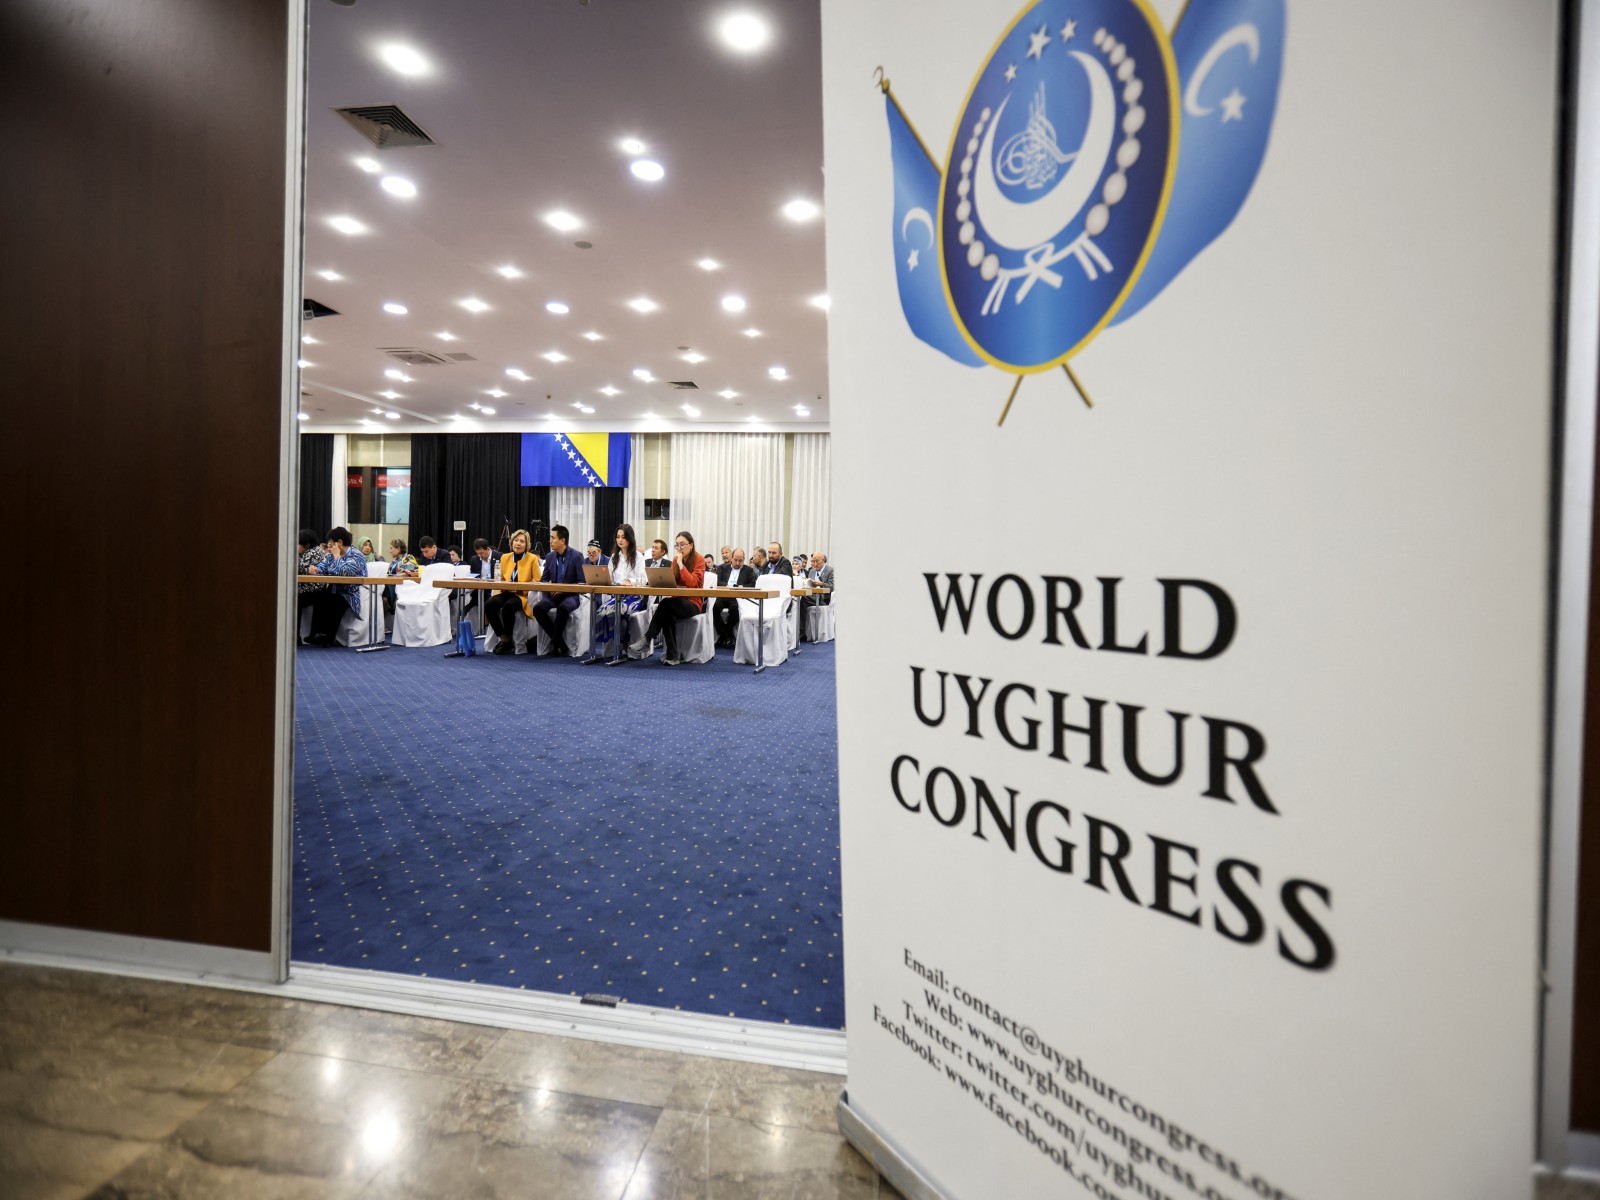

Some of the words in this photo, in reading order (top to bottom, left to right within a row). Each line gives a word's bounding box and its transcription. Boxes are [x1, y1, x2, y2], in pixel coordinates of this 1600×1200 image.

[922, 571, 1239, 661] WORLD
[909, 665, 1283, 817] UYGHUR
[890, 753, 1337, 974] CONGRESS
[872, 1002, 942, 1073] Facebook:
[903, 947, 950, 993] Email:
[901, 999, 964, 1061] Twitter:
[966, 1050, 1173, 1200] twitter.com/uyghu
[923, 987, 964, 1032] Web:
[966, 1021, 1233, 1200] www.uyghurcongress.o
